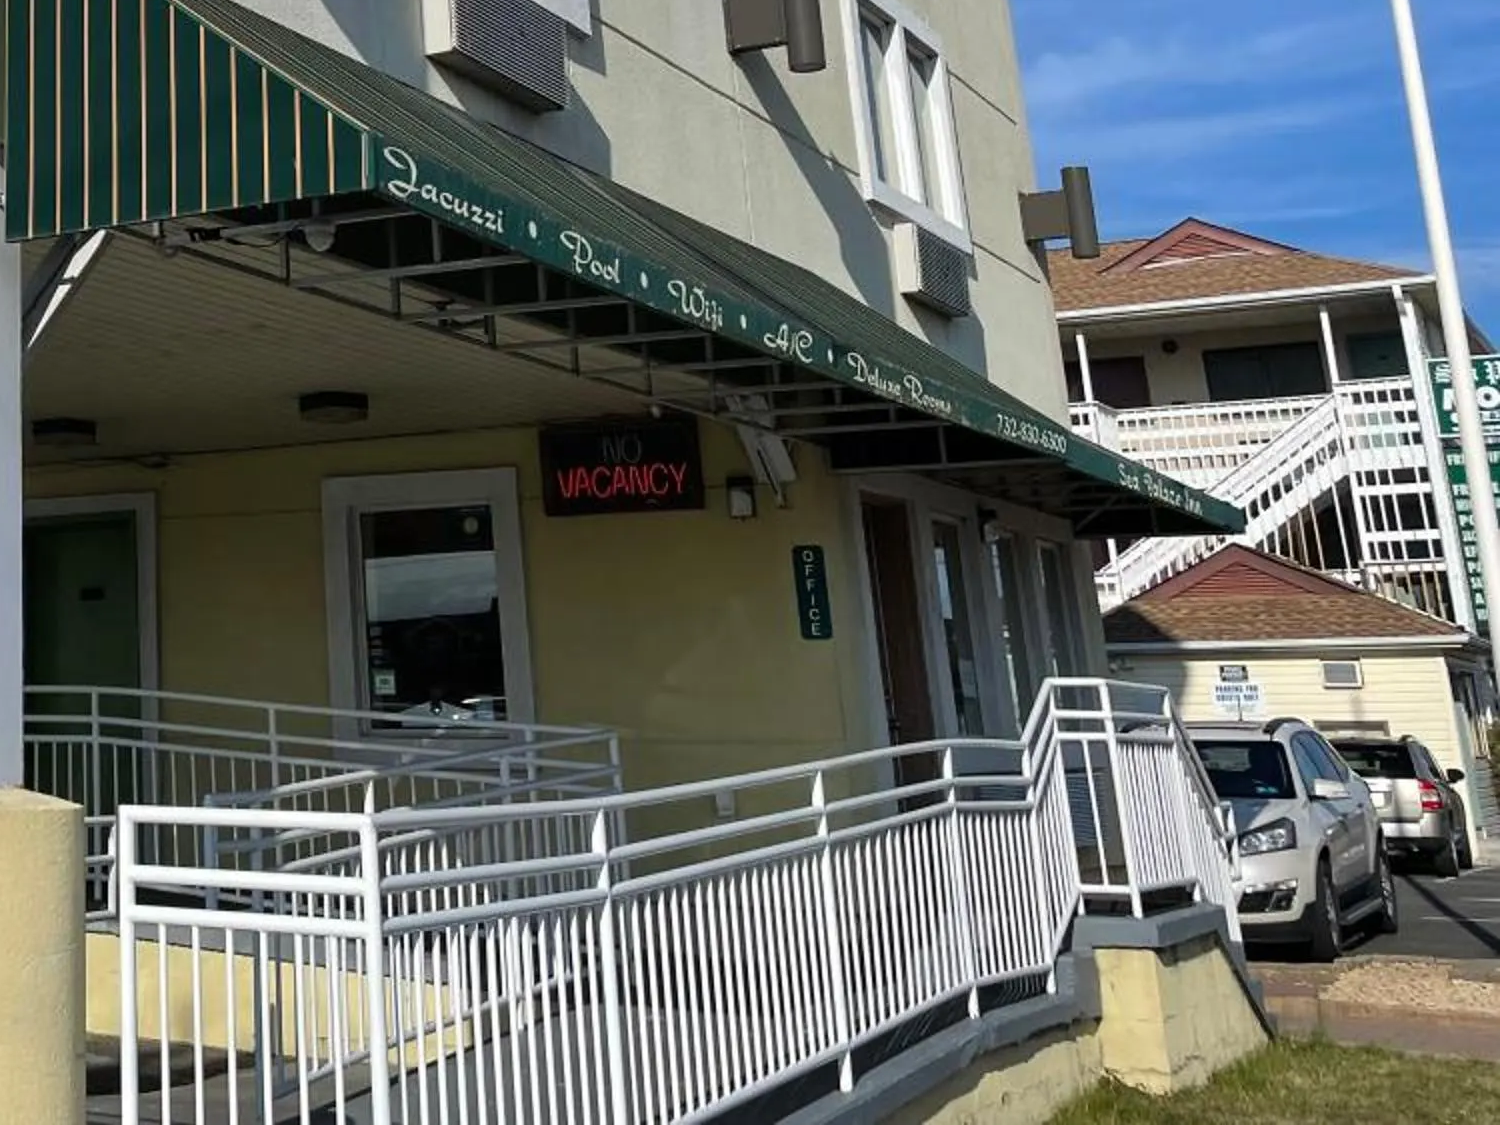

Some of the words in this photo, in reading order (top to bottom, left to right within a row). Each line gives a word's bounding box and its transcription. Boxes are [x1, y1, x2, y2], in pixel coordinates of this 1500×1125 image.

[383, 146, 505, 234] Jacuzzi
[560, 229, 621, 284] Pool
[763, 323, 813, 364] A/C
[846, 351, 901, 396] Deluxe
[903, 373, 951, 414] Rooms
[601, 432, 642, 464] NO
[996, 413, 1067, 454] 732-830-6300
[557, 461, 688, 499] VACANCY
[1117, 462, 1140, 492] Sea
[1143, 472, 1181, 507] Palace
[1183, 487, 1204, 516] Inn
[801, 549, 822, 637] OFFICE
